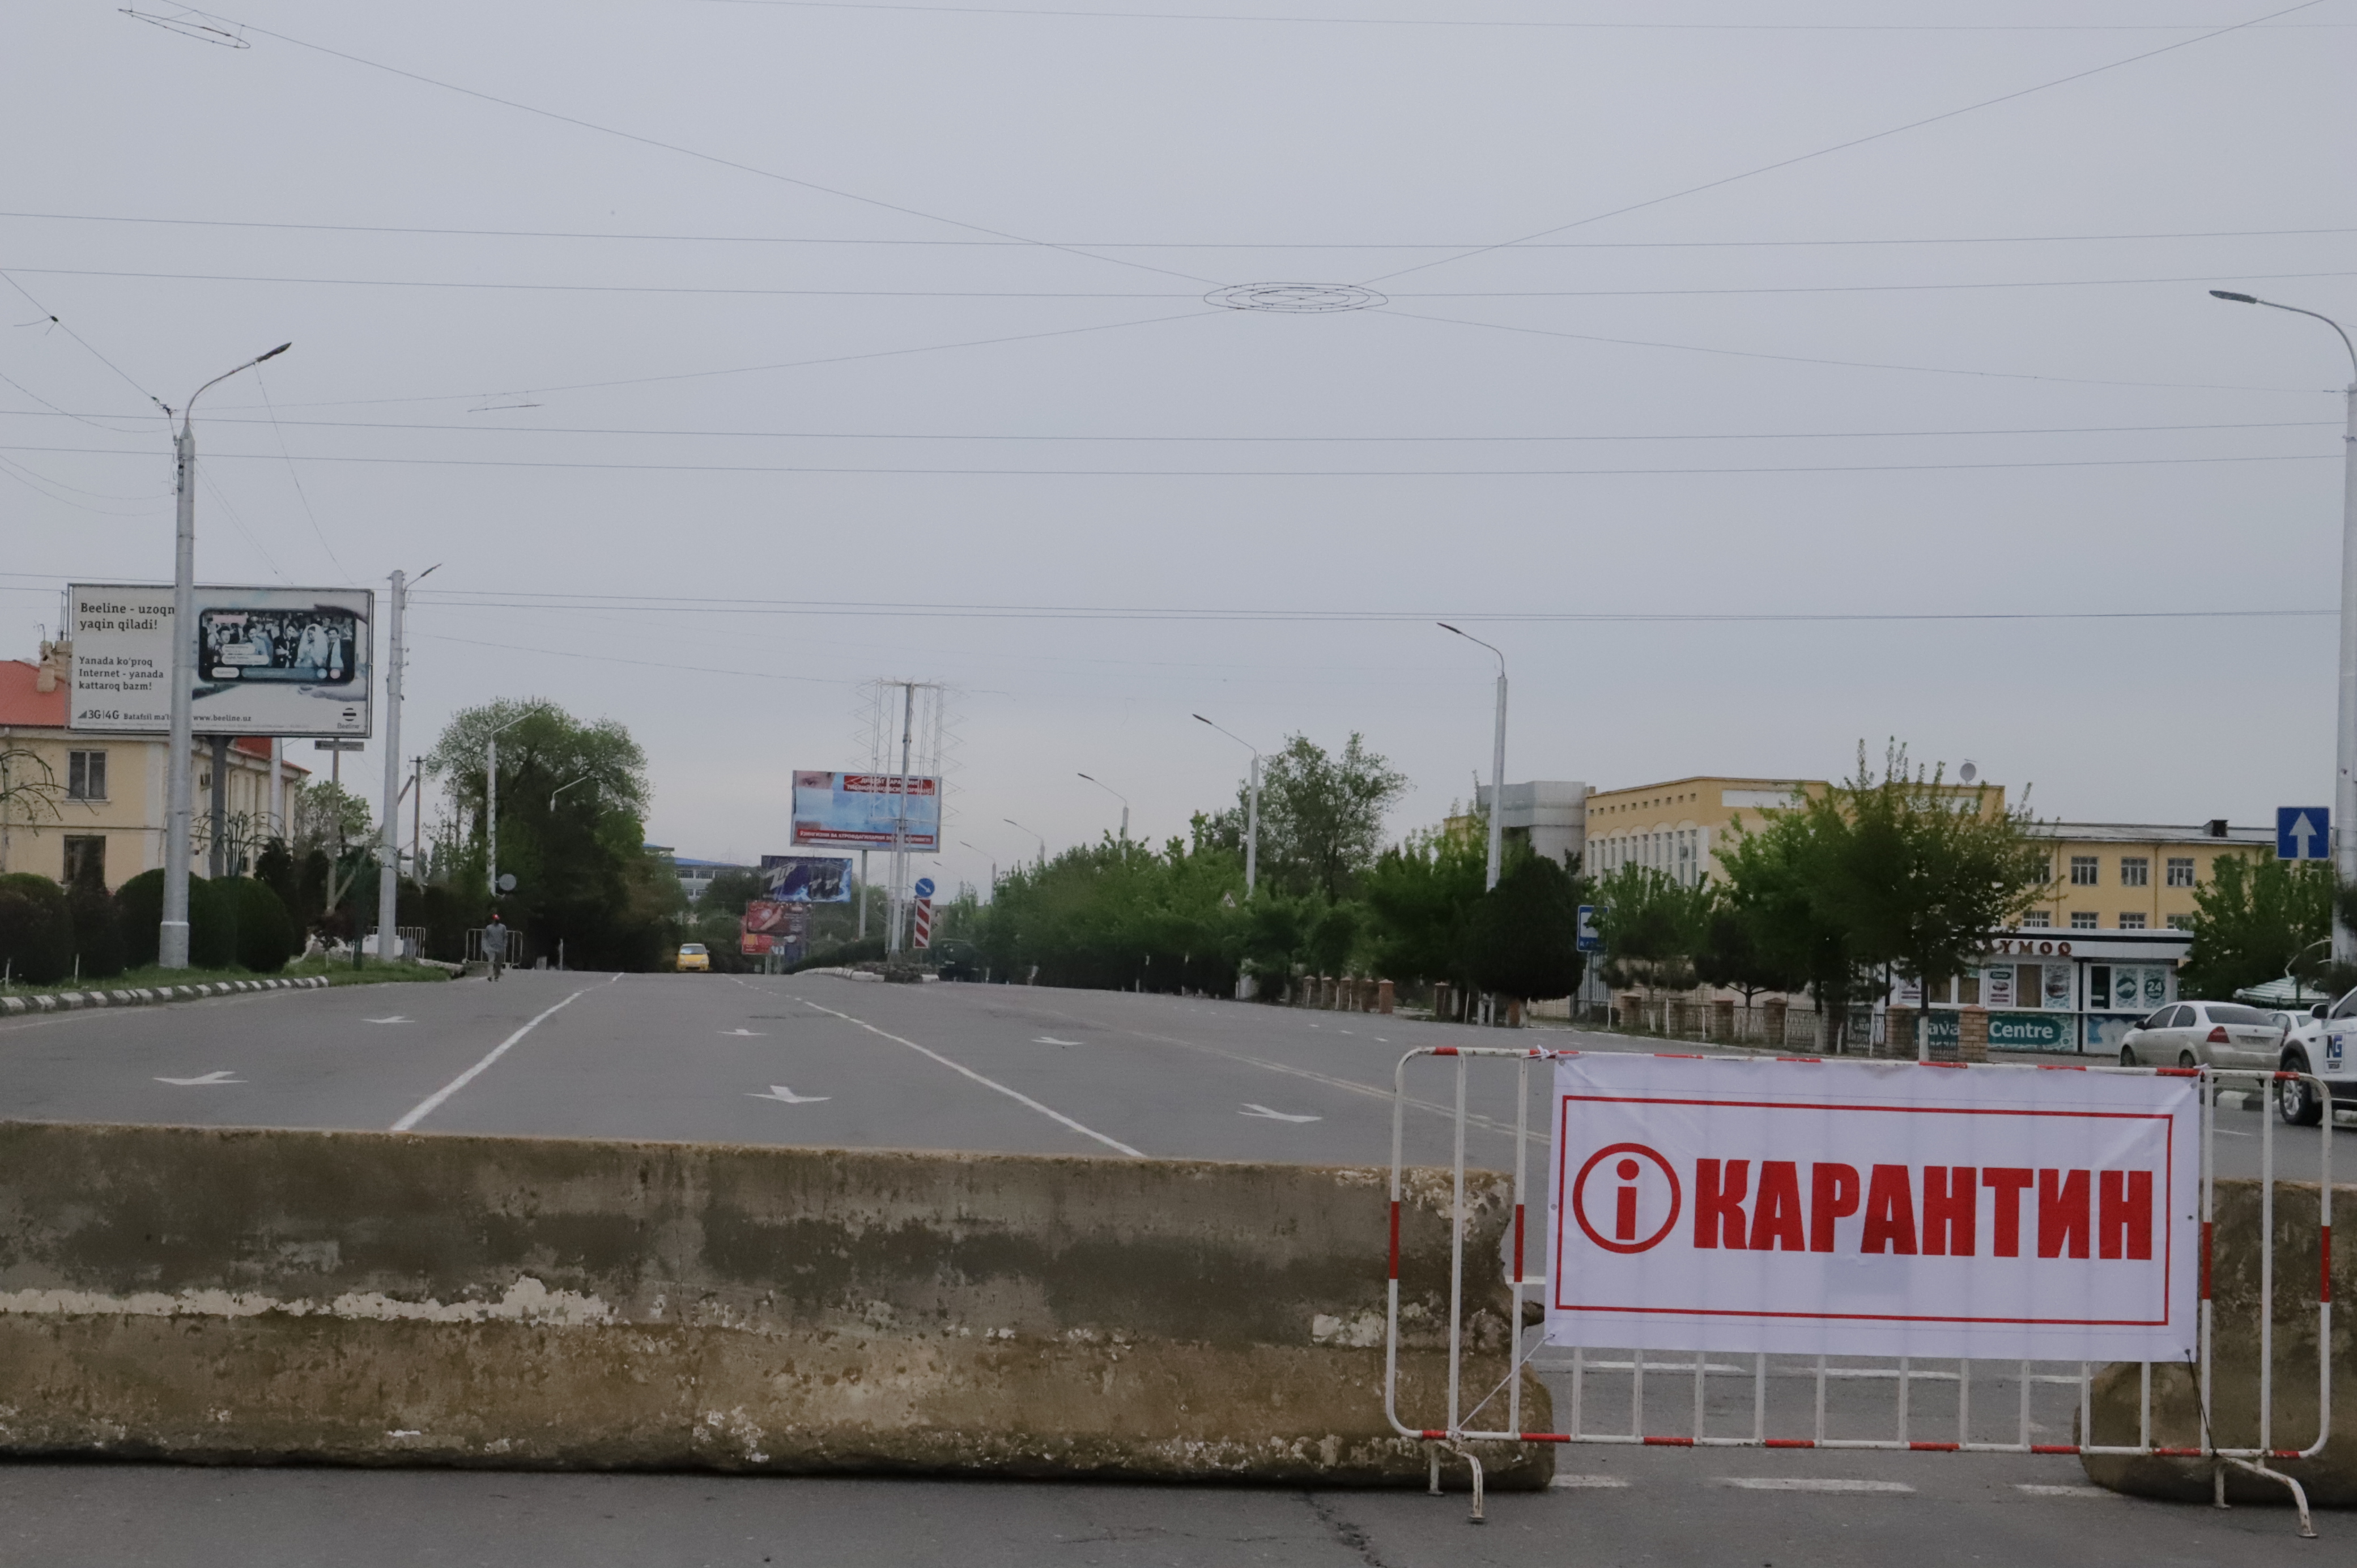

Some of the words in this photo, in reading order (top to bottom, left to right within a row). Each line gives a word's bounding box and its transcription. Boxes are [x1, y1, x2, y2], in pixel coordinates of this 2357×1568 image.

[80, 603, 126, 613] Beeline
[138, 606, 175, 616] uzoqn
[80, 619, 114, 631] yaqin
[118, 619, 157, 632] qiladi!
[79, 657, 114, 665] Yanada
[79, 669, 120, 678] Internet
[129, 670, 163, 679] yanada
[79, 681, 120, 692] kattaroq
[124, 681, 152, 691] bazm!
[1999, 940, 2071, 956] YMOQ
[2147, 981, 2162, 991] 24
[1989, 1021, 2053, 1039] Centre
[1694, 1157, 2153, 1261] КАРАНТИН
